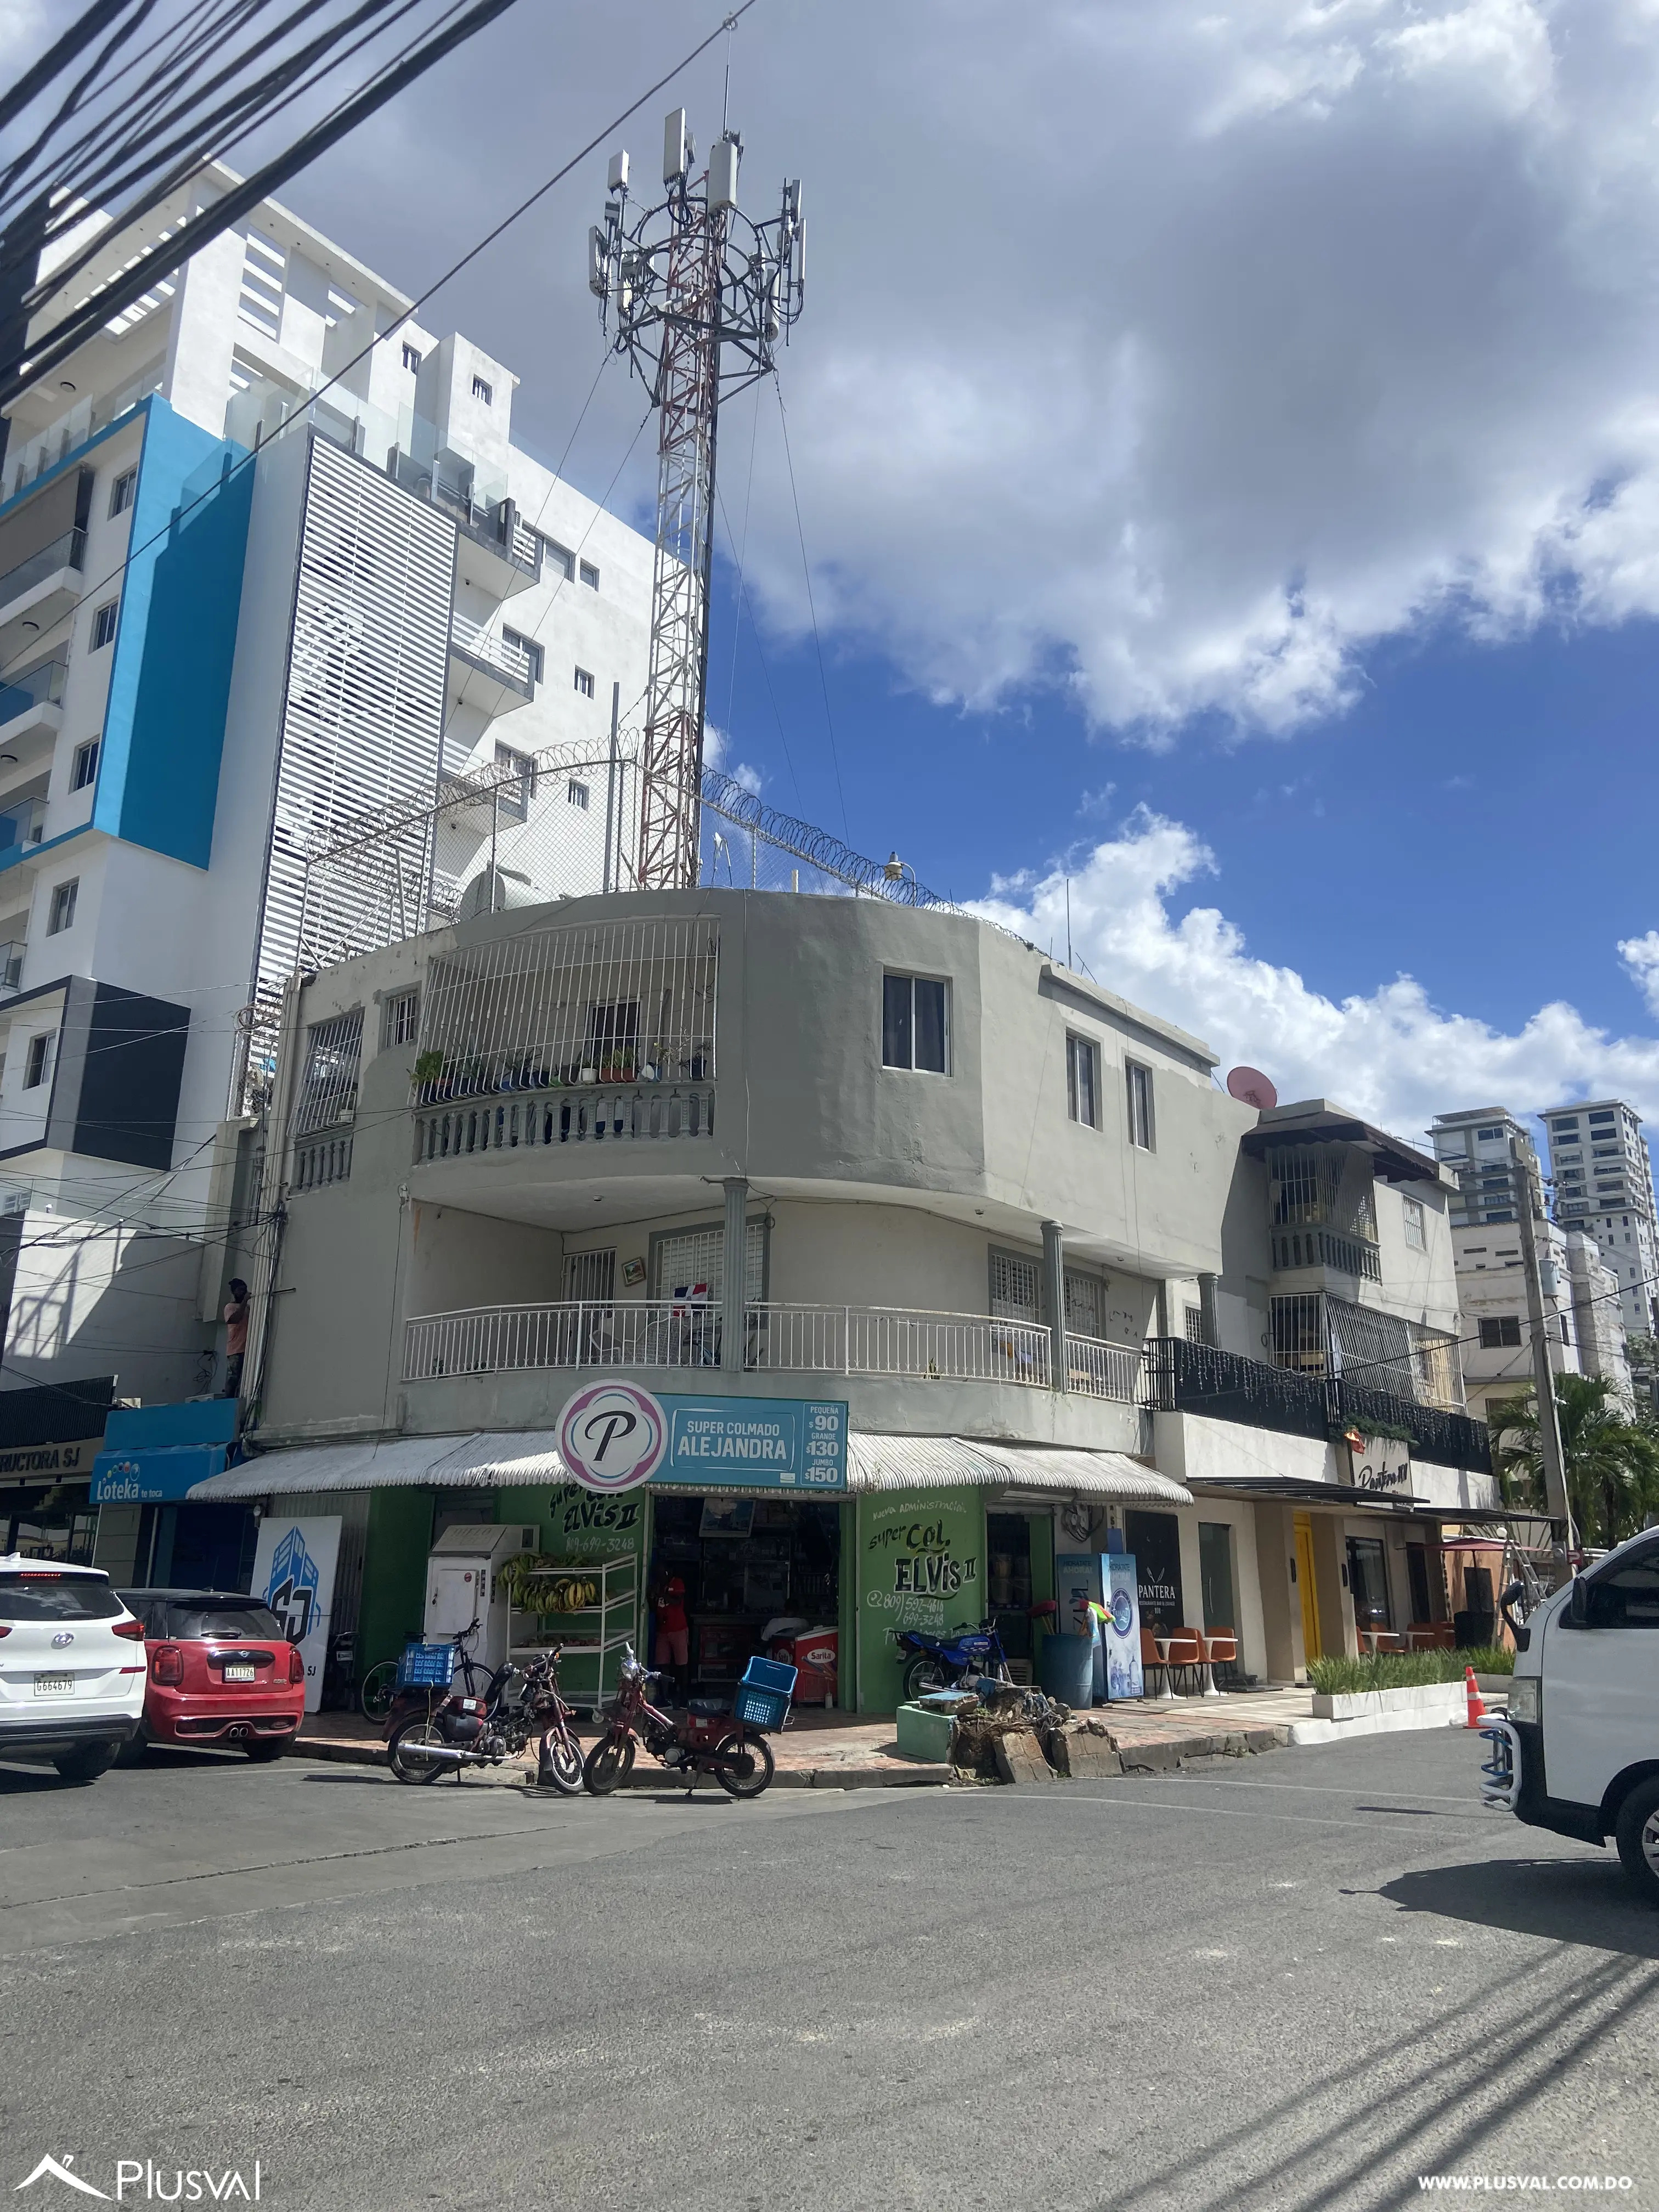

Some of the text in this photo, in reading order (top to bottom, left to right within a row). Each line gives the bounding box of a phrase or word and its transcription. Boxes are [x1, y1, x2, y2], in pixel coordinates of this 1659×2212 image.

[810, 1406, 839, 1414] PEQUEÑA
[687, 1420, 780, 1436] SUPER COLMADO
[809, 1415, 839, 1431] $90
[585, 1410, 636, 1462] P
[811, 1432, 836, 1440] GRANDE
[677, 1436, 787, 1460] ALEJANDRA
[805, 1441, 839, 1457] $130
[63, 1447, 81, 1467] SJ
[805, 1466, 838, 1482] $150
[97, 1479, 162, 1500] Loteka te toca
[1138, 1584, 1175, 1599] PANTERA
[903, 1612, 944, 1627] 699-3248
[227, 1668, 254, 1677] AA11726
[307, 1665, 317, 1676] SJ
[37, 1680, 72, 1691] G664679
